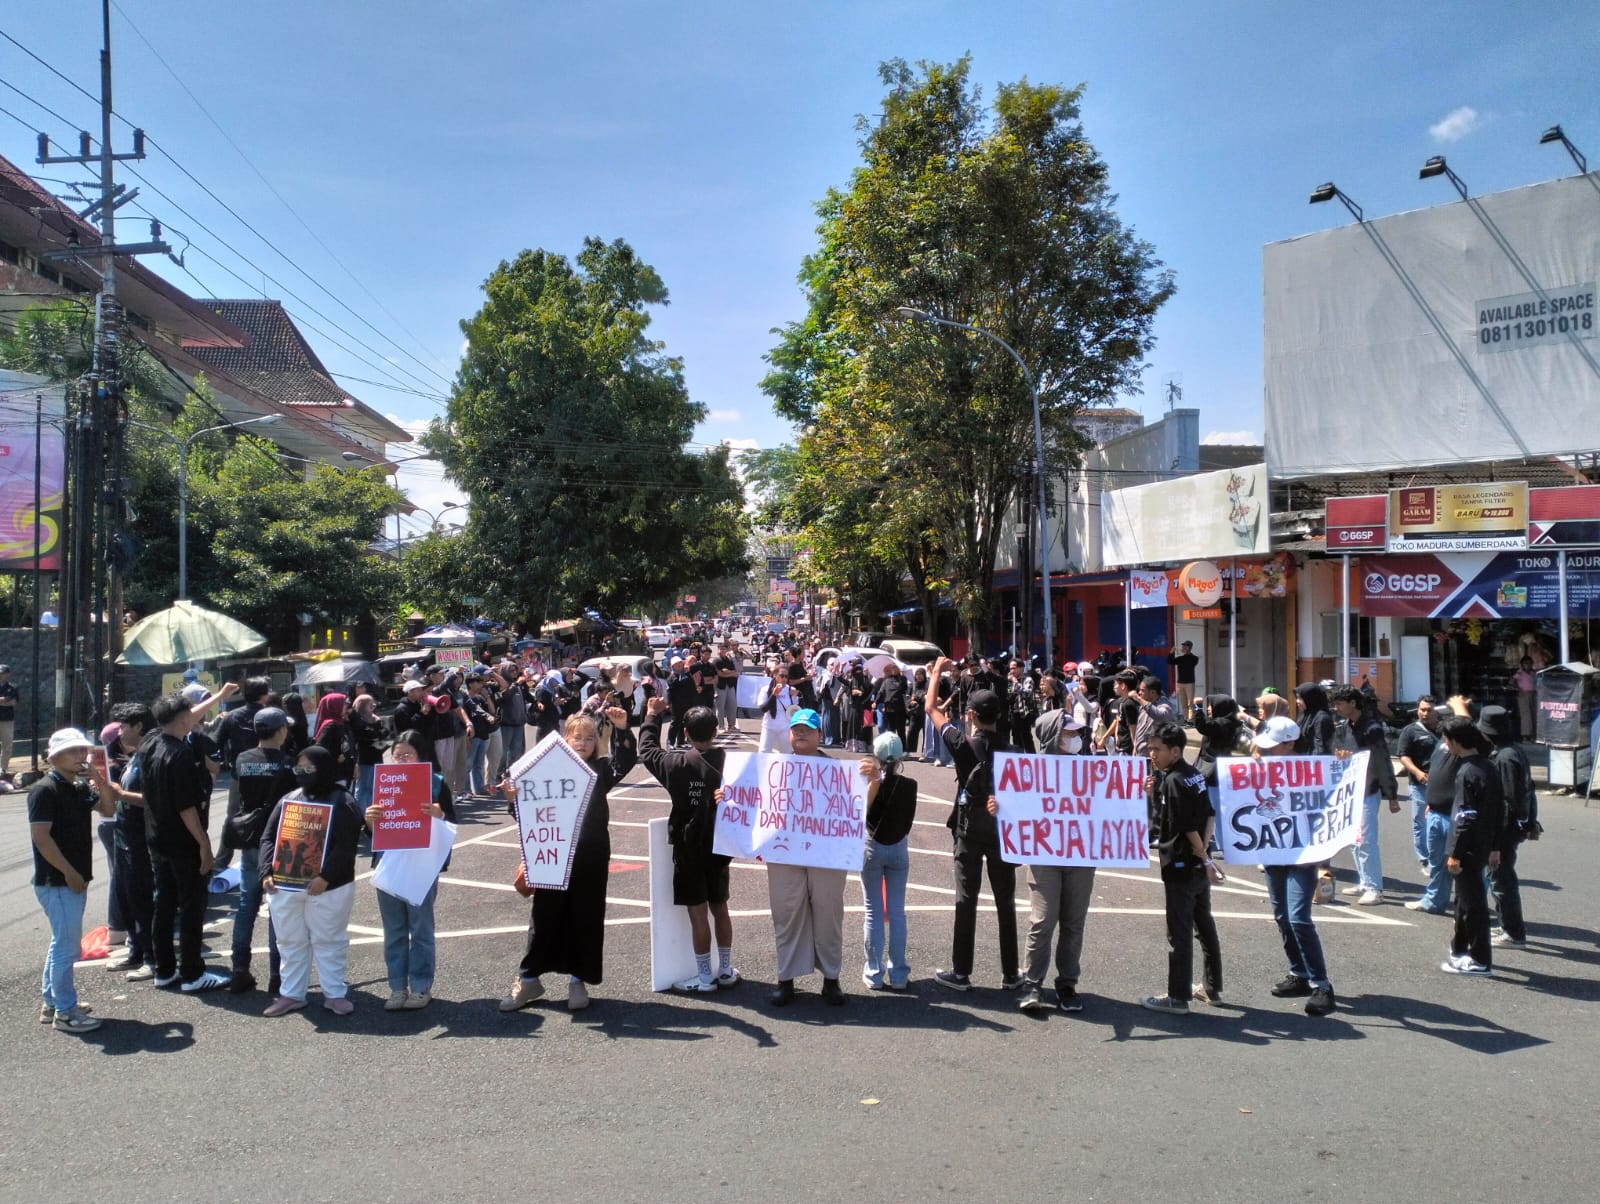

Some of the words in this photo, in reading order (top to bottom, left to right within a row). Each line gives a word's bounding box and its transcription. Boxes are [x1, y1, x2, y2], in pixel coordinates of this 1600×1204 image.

[1480, 300, 1547, 325] AVAILABLE
[1550, 293, 1593, 314] SPACE
[1480, 312, 1593, 344] 0811301018
[1350, 530, 1374, 540] GGSP
[1391, 542, 1415, 550] TOKO
[1416, 541, 1454, 549] MADURA
[1456, 539, 1519, 549] SUMBERDANA
[1520, 539, 1526, 547] 3
[1517, 557, 1551, 569] TOKO
[1557, 556, 1600, 568] ADUR
[1388, 574, 1441, 592] GGSP
[1550, 710, 1566, 719] ADA
[379, 773, 408, 784] Capek
[768, 760, 852, 794] CIPTAKAN
[998, 757, 1061, 794] ADILI
[1071, 759, 1145, 800] UPAH
[1228, 760, 1324, 791] BURUH
[379, 784, 403, 796] kerja,
[520, 777, 577, 802] R.I.P.
[1290, 781, 1356, 812] BUKAN
[299, 805, 323, 815] BEBAN
[379, 796, 395, 807] gaji
[722, 784, 763, 809] DUNIA
[769, 788, 814, 814] KERJA
[822, 792, 862, 821] YANG
[1042, 796, 1092, 815] DAN
[285, 811, 303, 821] GANDA
[535, 806, 557, 824] KE
[722, 806, 750, 827] ADIL
[759, 811, 787, 831] DAN
[792, 815, 864, 839] MANUSIAWI
[283, 819, 322, 831] PEREMPUAN!
[379, 820, 421, 830] seberapa
[1232, 805, 1304, 851] SAPI
[1306, 799, 1354, 845] PERAH
[525, 826, 566, 843] ADIL
[1001, 818, 1086, 859] KERJA
[1088, 819, 1149, 860] LAYAK
[534, 847, 558, 865] AN
